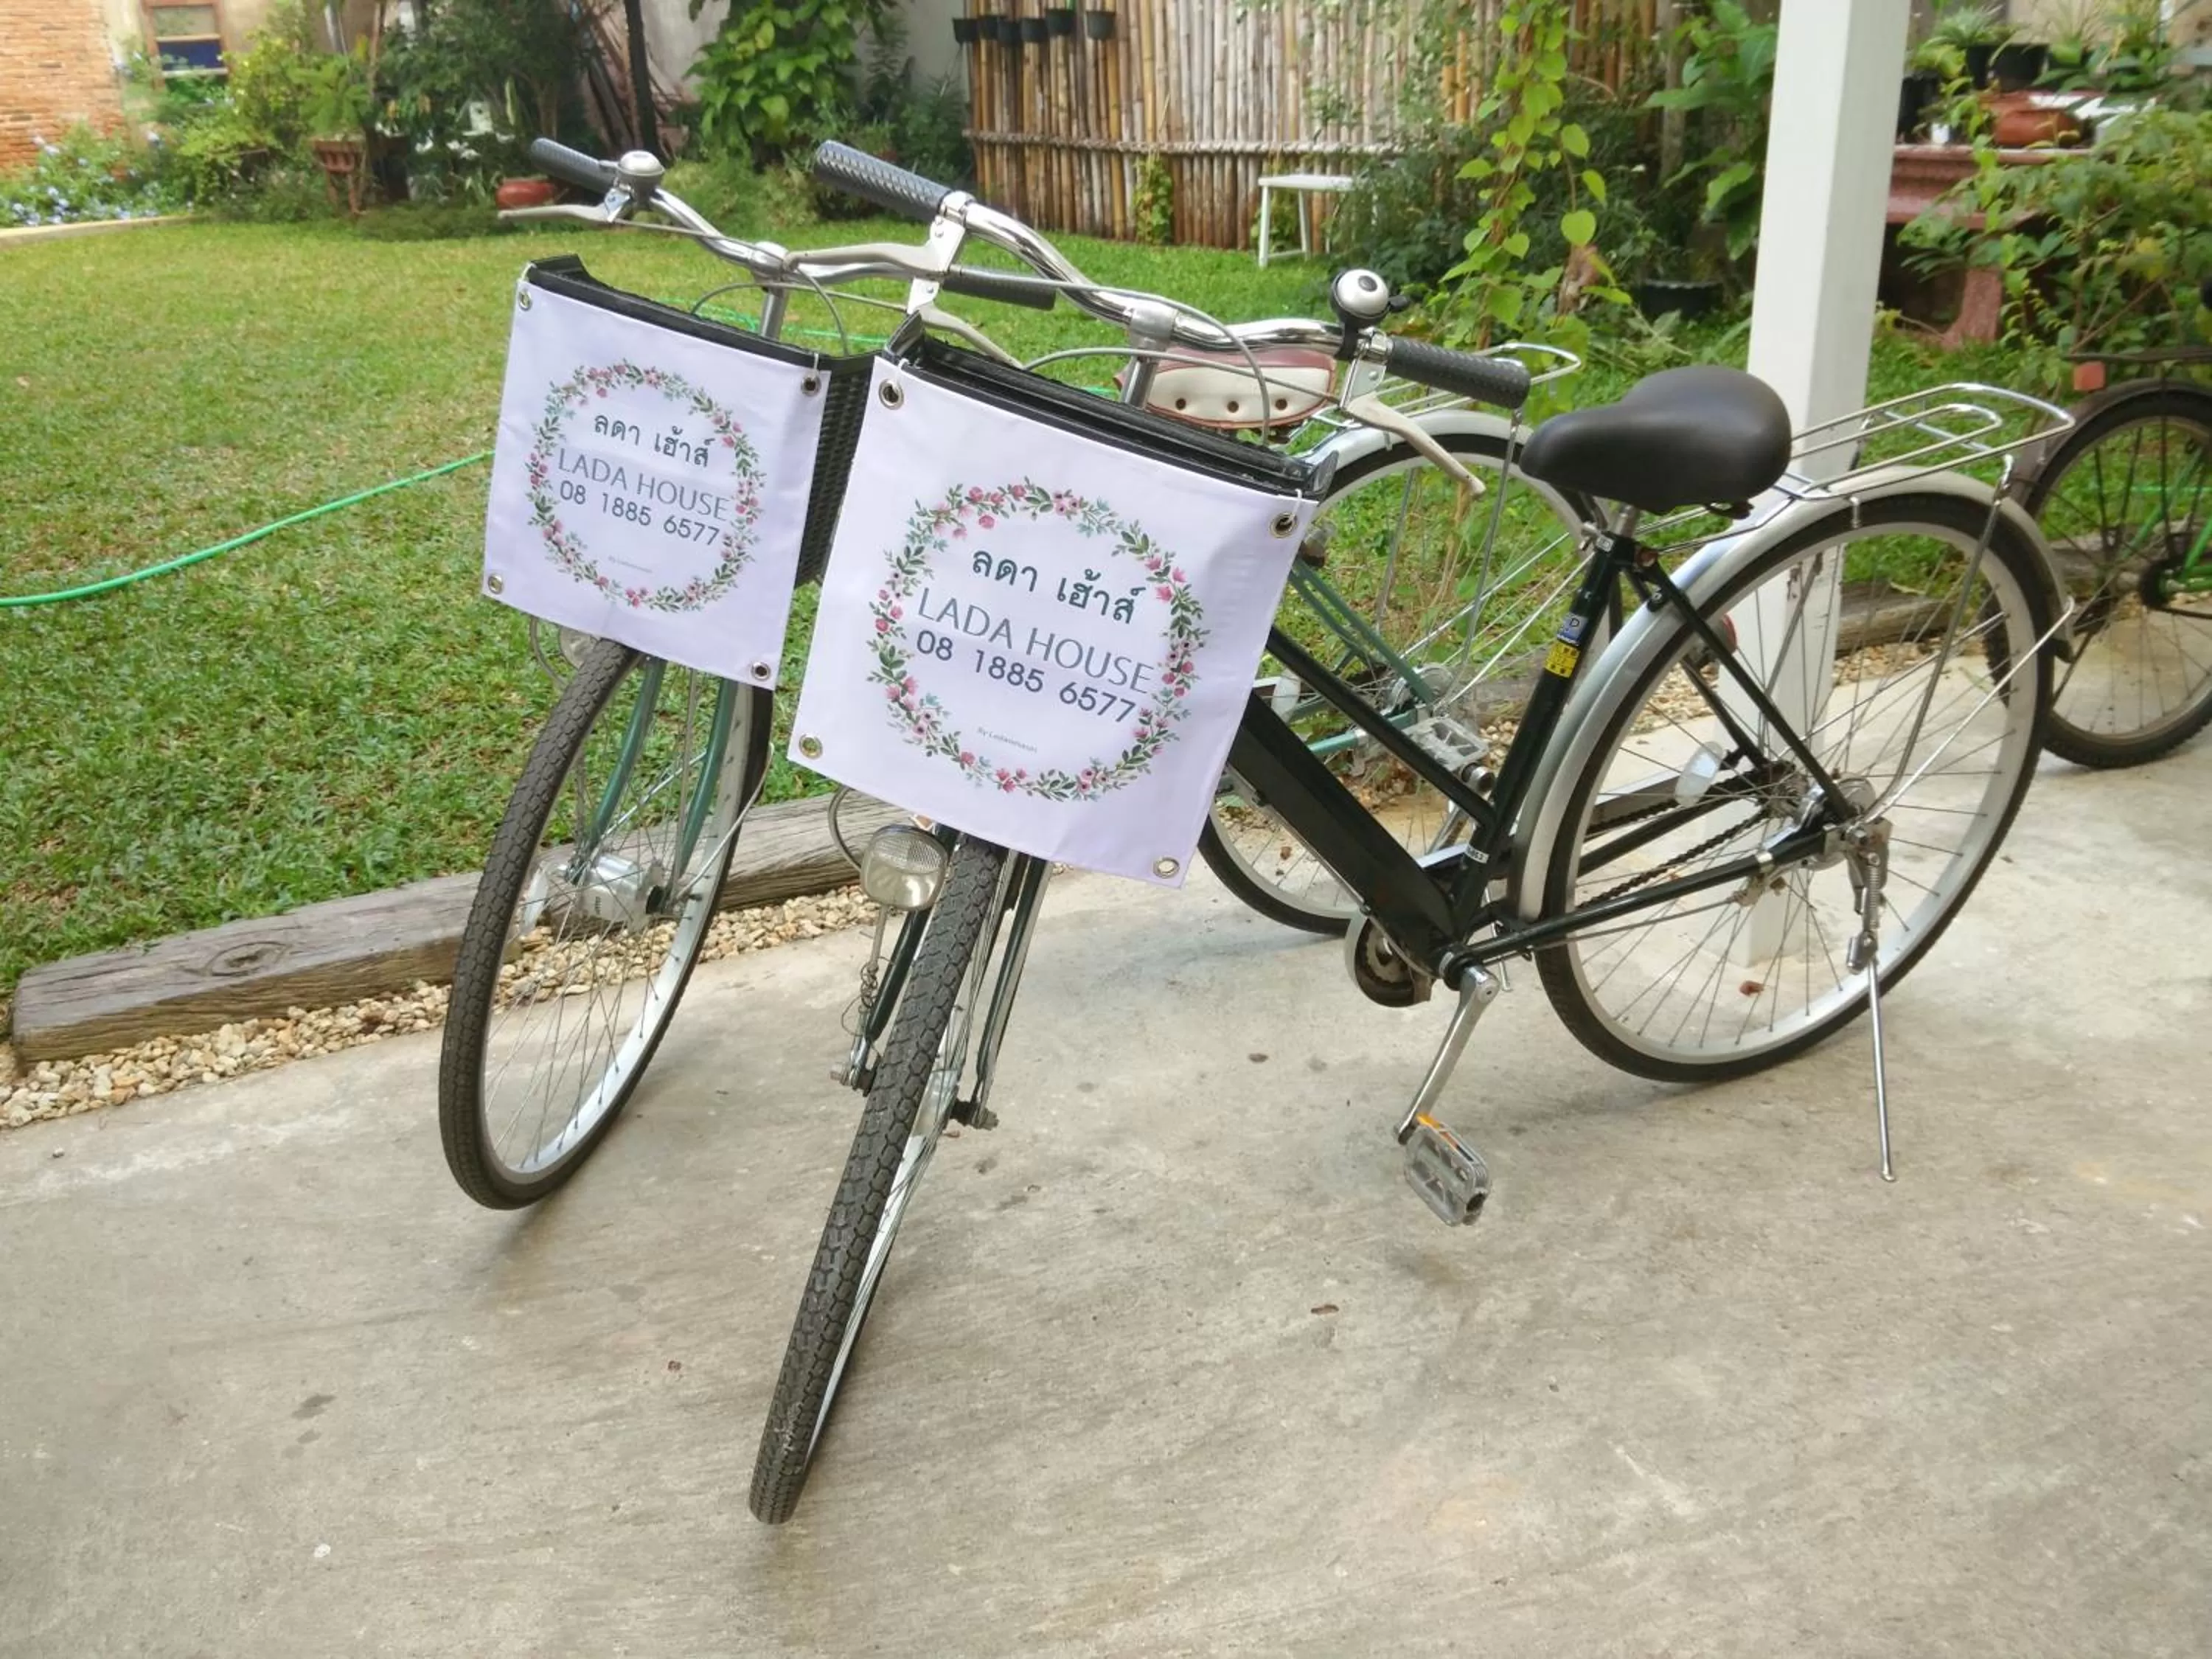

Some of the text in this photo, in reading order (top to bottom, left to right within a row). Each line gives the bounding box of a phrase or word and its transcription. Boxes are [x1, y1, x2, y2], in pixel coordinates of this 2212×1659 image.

[594, 415, 715, 467] ลดา เฮ้าส์
[558, 448, 730, 521] LADA HOUSE
[560, 480, 720, 546] 08 1885 6577
[973, 551, 1147, 625] ลดา เฮ้าส์
[917, 630, 1136, 722] 08 1885 6577
[918, 588, 1155, 694] LADA HOUSE
